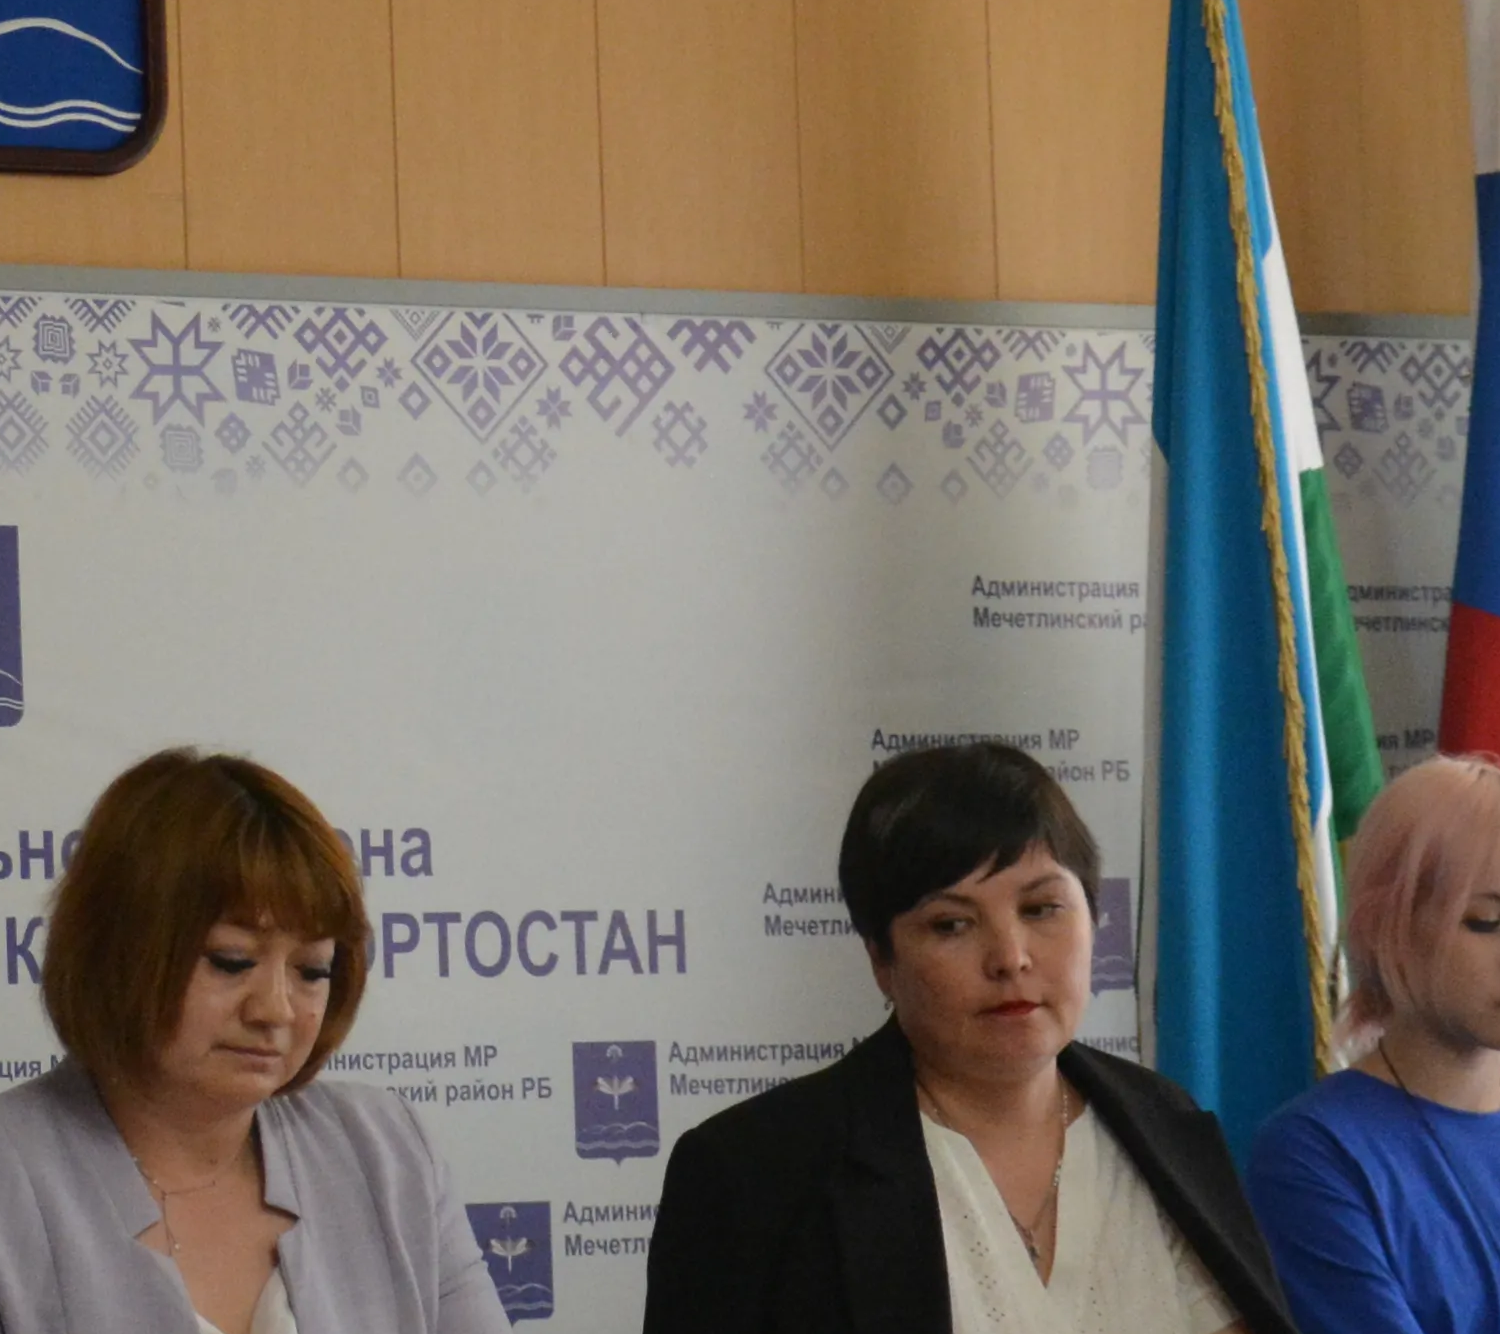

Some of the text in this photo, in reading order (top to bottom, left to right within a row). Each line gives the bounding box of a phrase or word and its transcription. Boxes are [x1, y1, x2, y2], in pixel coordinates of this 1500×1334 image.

[972, 576, 1139, 600] Администрация
[973, 607, 1123, 630] Мечетлинский
[1049, 730, 1079, 750] МР
[1050, 761, 1129, 782] йон РБ
[465, 1046, 497, 1067] МР
[669, 1041, 845, 1065] Администрация
[445, 1080, 514, 1106] район
[522, 1078, 552, 1099] РБ
